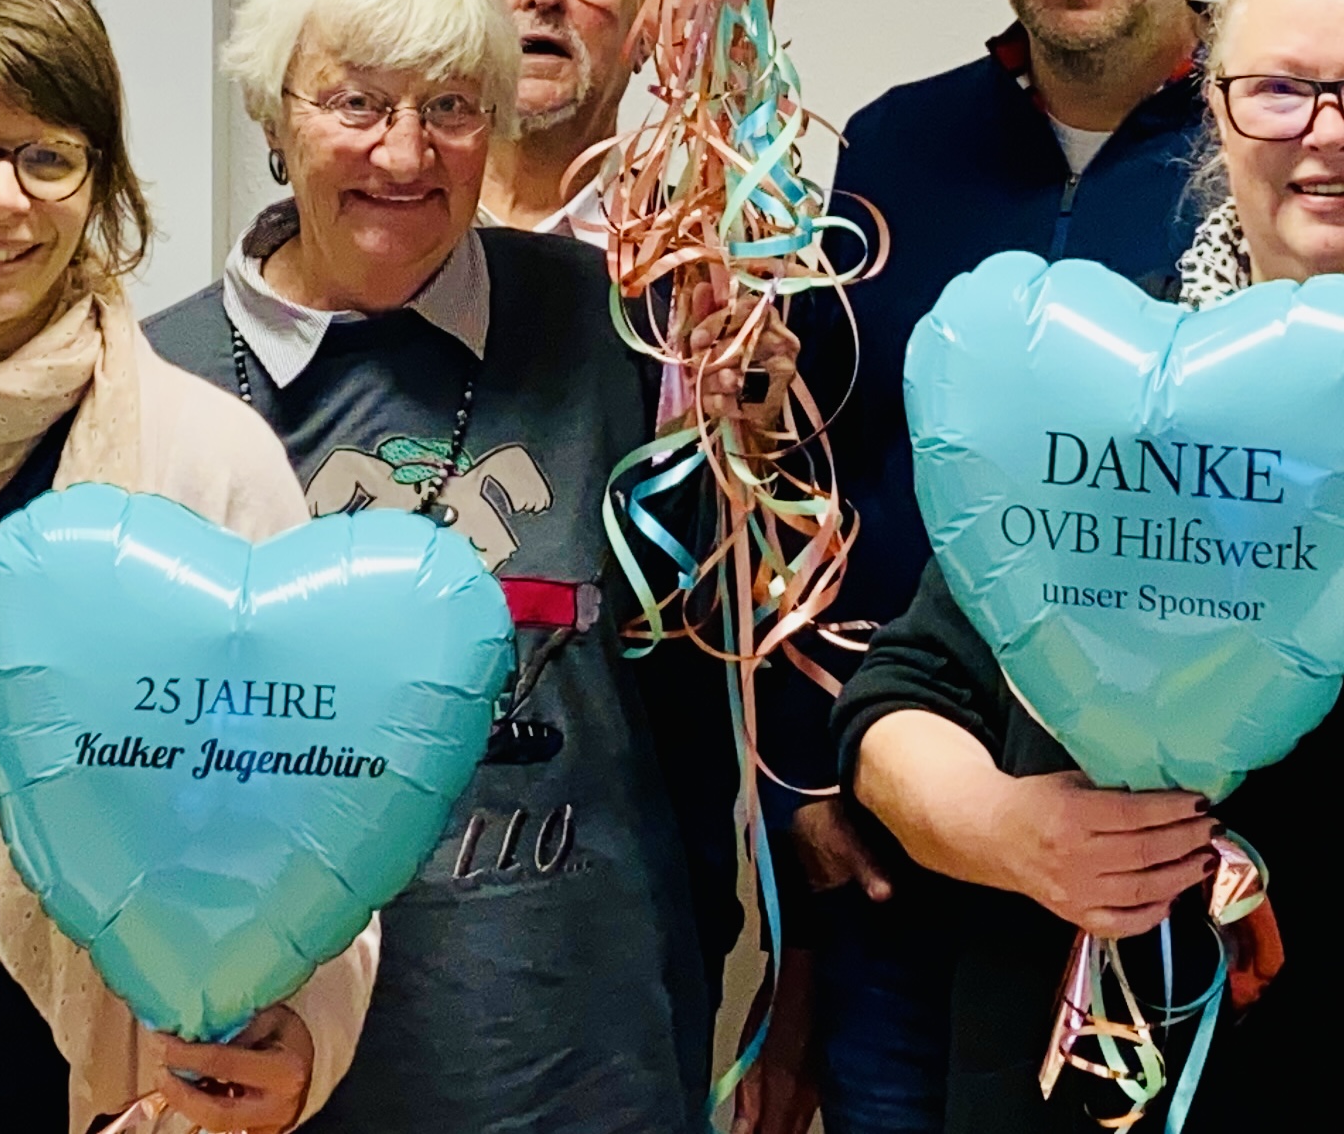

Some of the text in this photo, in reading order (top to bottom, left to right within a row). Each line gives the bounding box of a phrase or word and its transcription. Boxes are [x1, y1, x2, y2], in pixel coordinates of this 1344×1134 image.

[1042, 431, 1285, 504] DANKE
[1001, 505, 1319, 571] OVB Hilfswerk
[1043, 582, 1266, 622] unser Sponsor
[134, 676, 337, 725] 25 JAHRE
[75, 732, 389, 784] Kalker Jugendbüro
